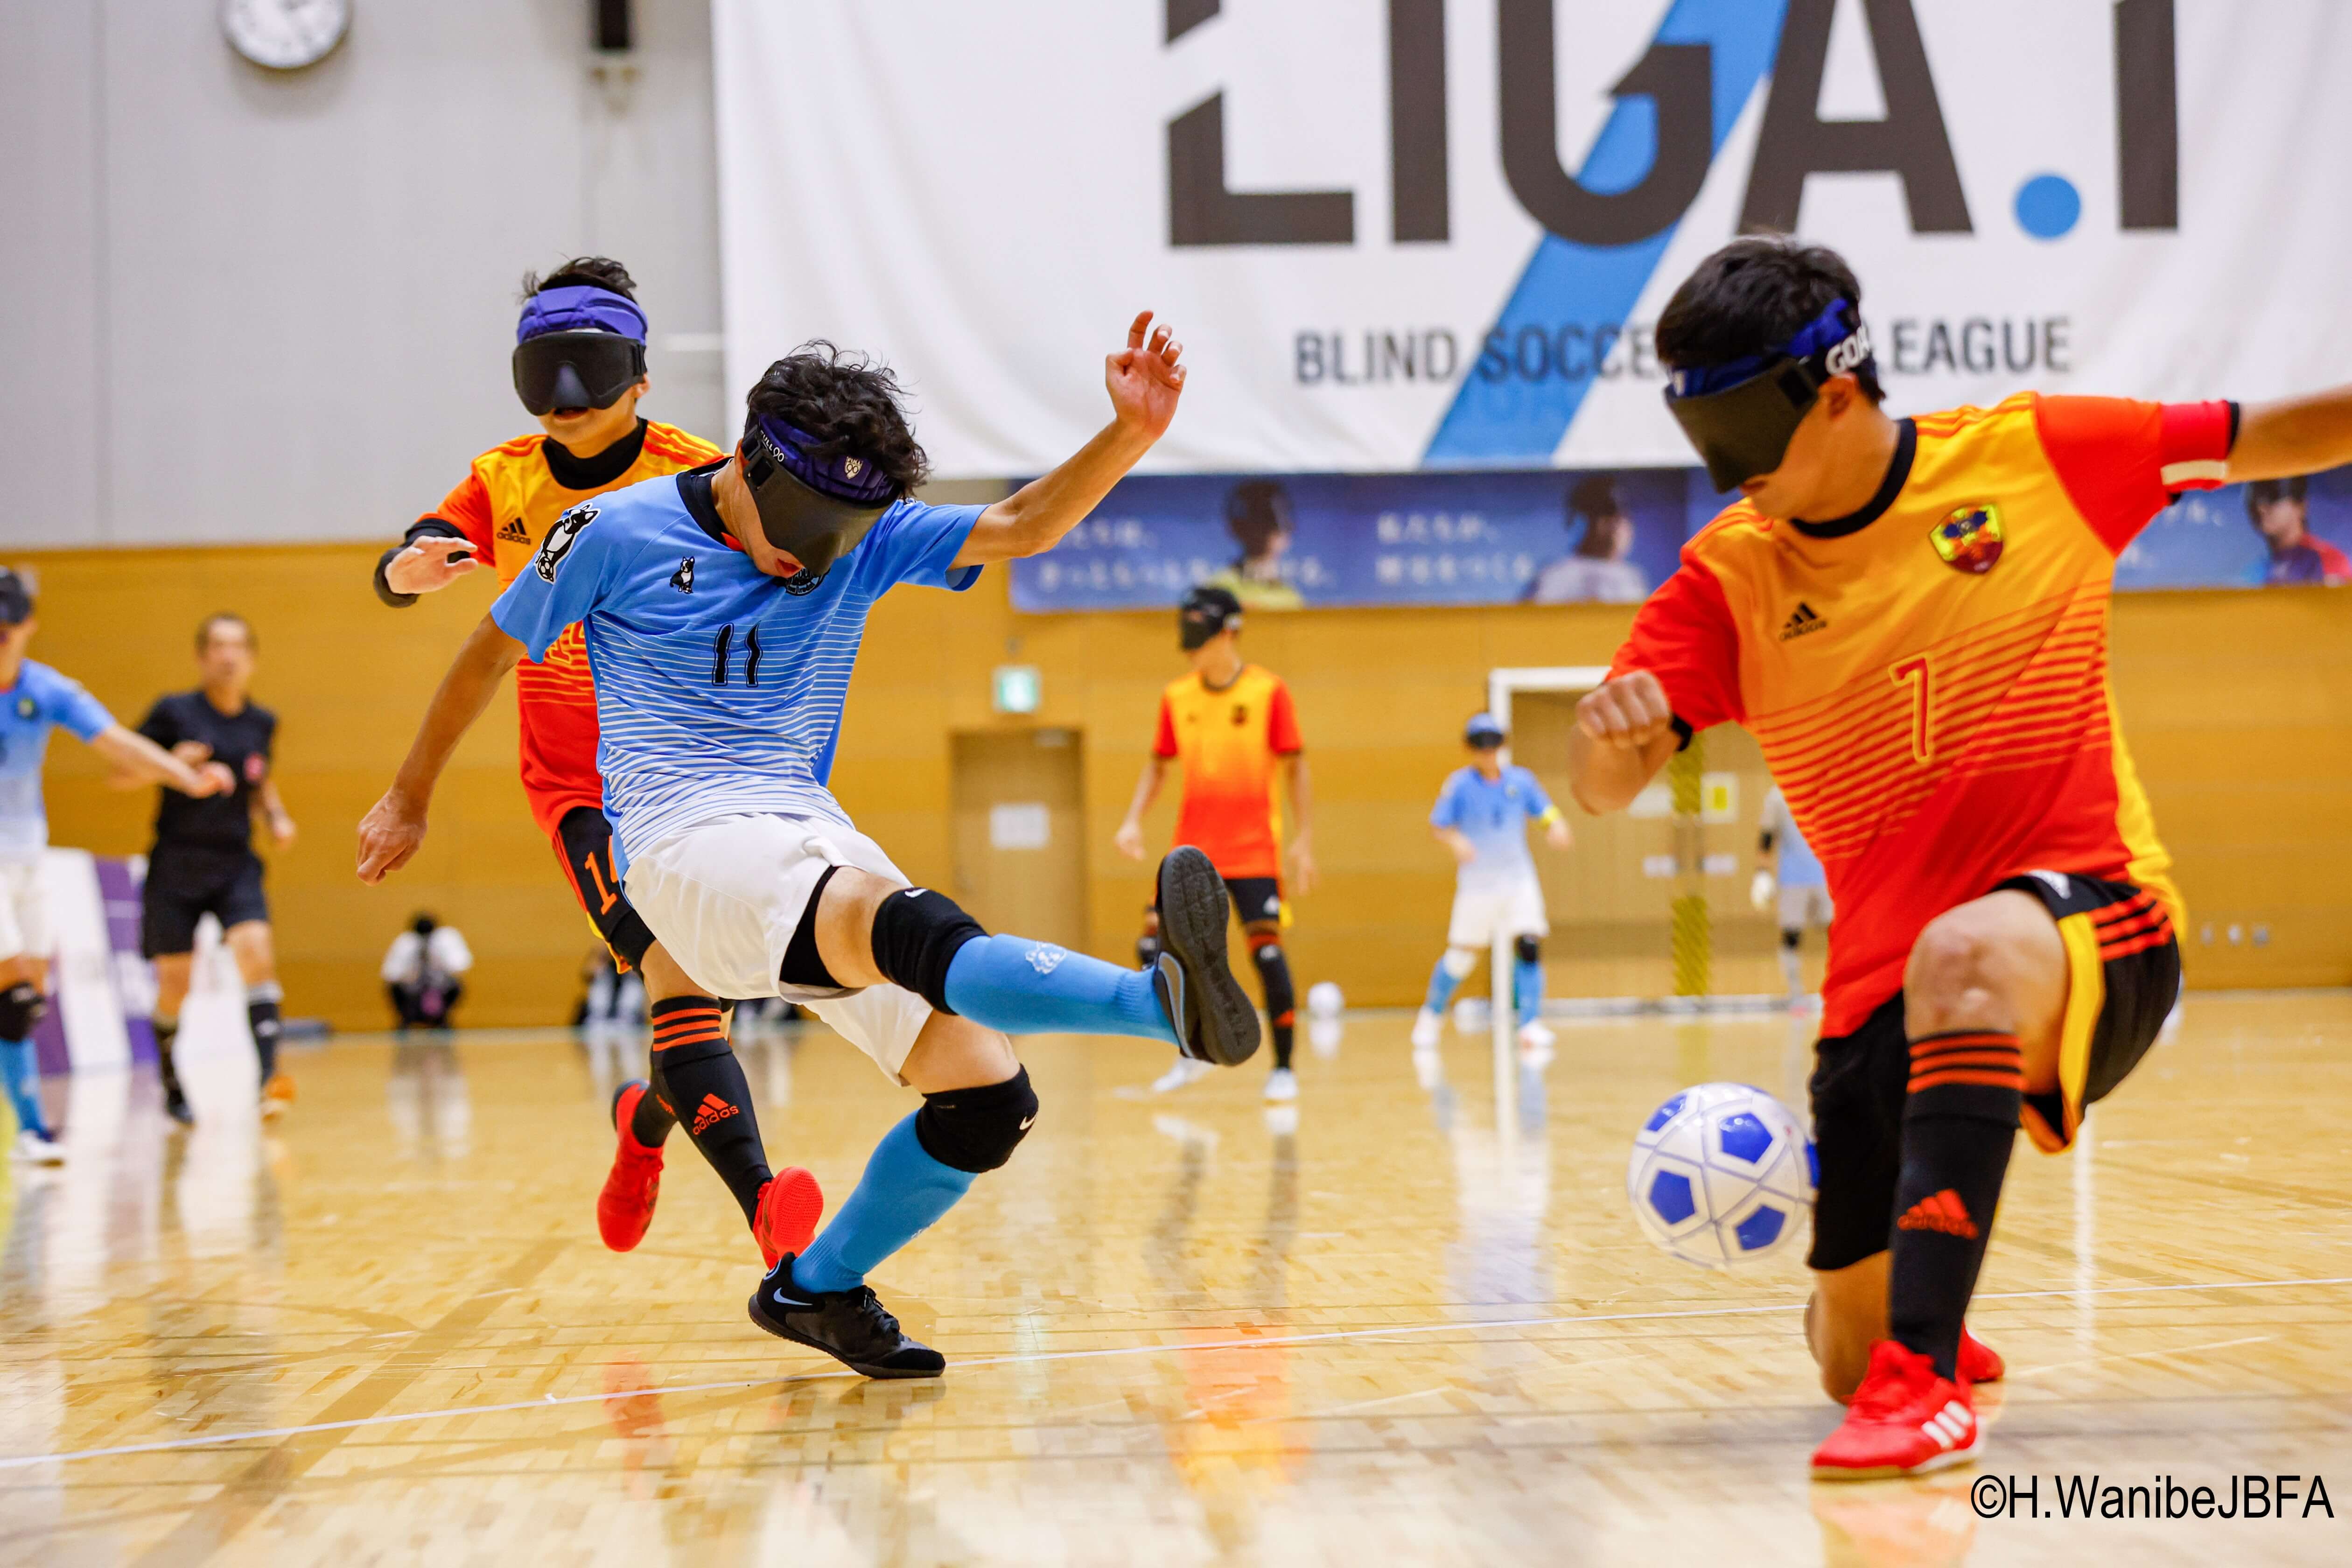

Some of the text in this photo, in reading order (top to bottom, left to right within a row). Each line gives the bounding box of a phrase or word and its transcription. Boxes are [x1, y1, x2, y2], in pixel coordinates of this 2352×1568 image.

[1295, 317, 2071, 384] BLIND SOCCE EAGUE
[773, 447, 785, 462] 90
[496, 532, 531, 546] adidas
[712, 620, 763, 687] 11
[1888, 653, 1931, 764] 7
[693, 1105, 739, 1135] adidas
